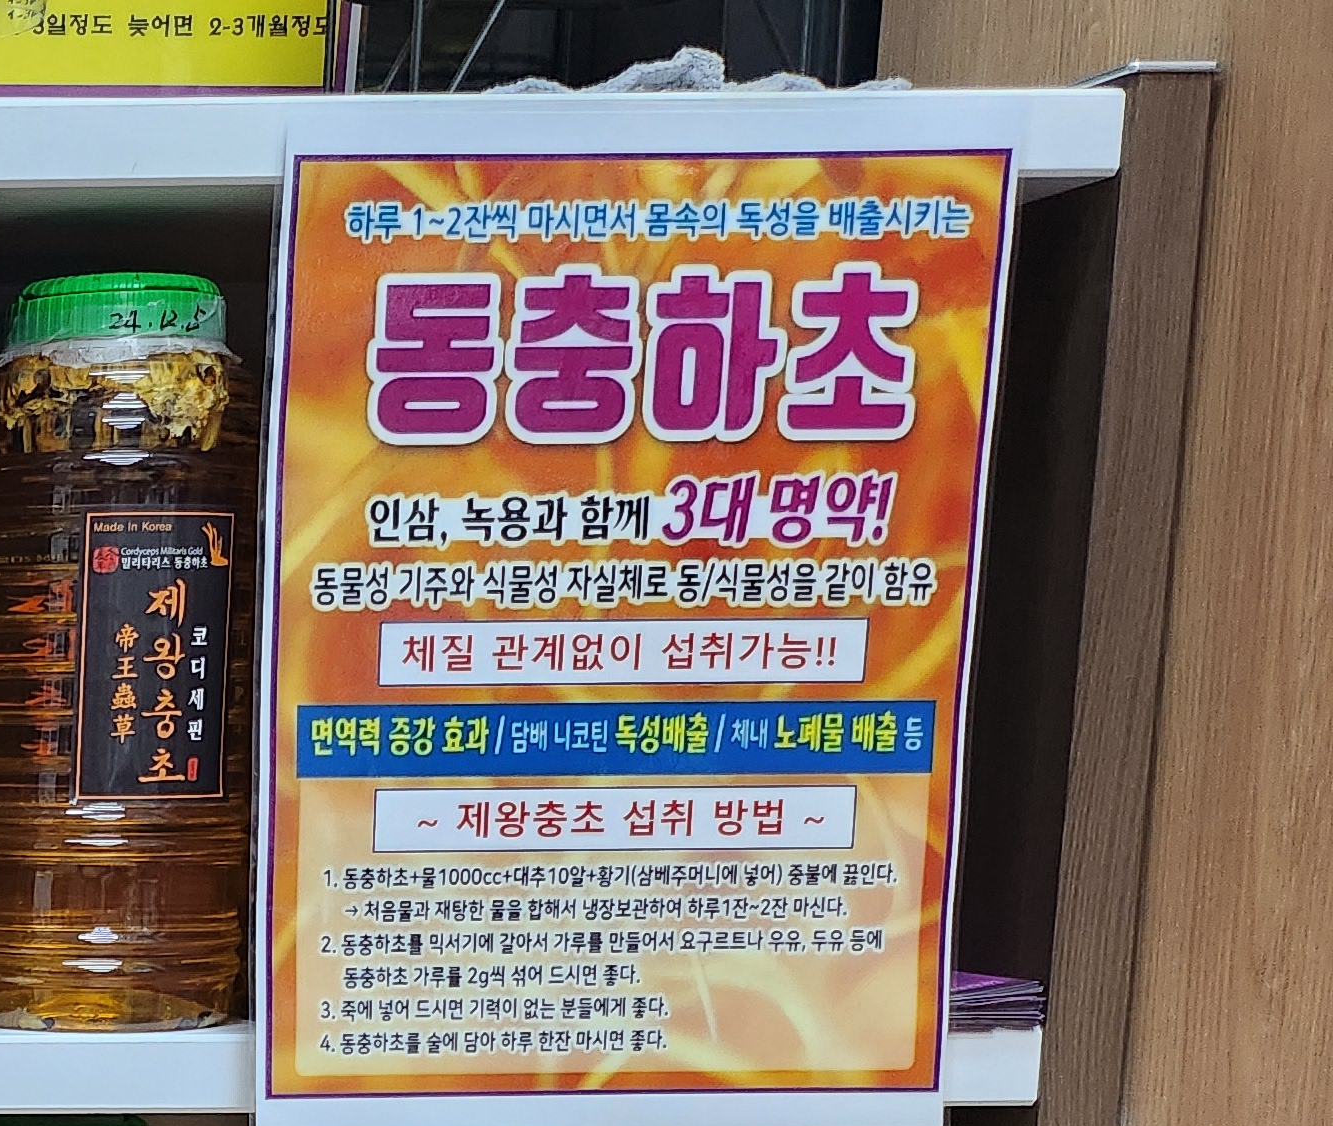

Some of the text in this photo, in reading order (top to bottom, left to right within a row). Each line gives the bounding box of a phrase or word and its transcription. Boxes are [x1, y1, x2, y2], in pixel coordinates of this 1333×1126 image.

[348, 199, 969, 237] 하루 1~2잔씩 마시면서 몸속의 독성을 배출시키는
[375, 270, 917, 434] 동충하초
[93, 521, 124, 533] Made
[142, 521, 173, 533] Korea
[370, 473, 892, 545] 인삼, 녹용과 함께 3대 명약!
[314, 561, 933, 606] 동물성 기주와 식물성 자실체로 동/식물성을 같이 함유
[402, 632, 837, 672] 체질 관계없이 섭취가능!!
[138, 578, 186, 782] 제왕충초
[310, 713, 923, 755] 면역력 증강 효과 담배 니코틴 독성배출 체내 노폐물 배출 등
[456, 798, 784, 838] 제왕충초 섭취 방법
[323, 869, 338, 888] 1.
[743, 863, 783, 887] 넣어)
[787, 863, 838, 886] 중불에
[842, 863, 897, 886] 끓인다.
[364, 899, 431, 923] 처음물과
[434, 899, 485, 922] 재탕한
[489, 899, 523, 922] 물을
[527, 898, 577, 921] 합해서
[582, 897, 682, 921] 냉장보관하여
[793, 896, 847, 919] 마신다.
[321, 929, 883, 957] 2. 동충하초를 믹서기에 갈아서 가루를 만들어서 요구르트나 우유, 두유 등에
[343, 964, 641, 989] 동충하초 가루를 2g씩 섞어 드시면 좋다.
[321, 996, 669, 1022] 3. 죽에 넣어 드시면 기력이 없는 분들에게 좋다.
[319, 1029, 667, 1055] 4. 동충하초를 술에 담아 하루 한잔 마시면 좋다.
